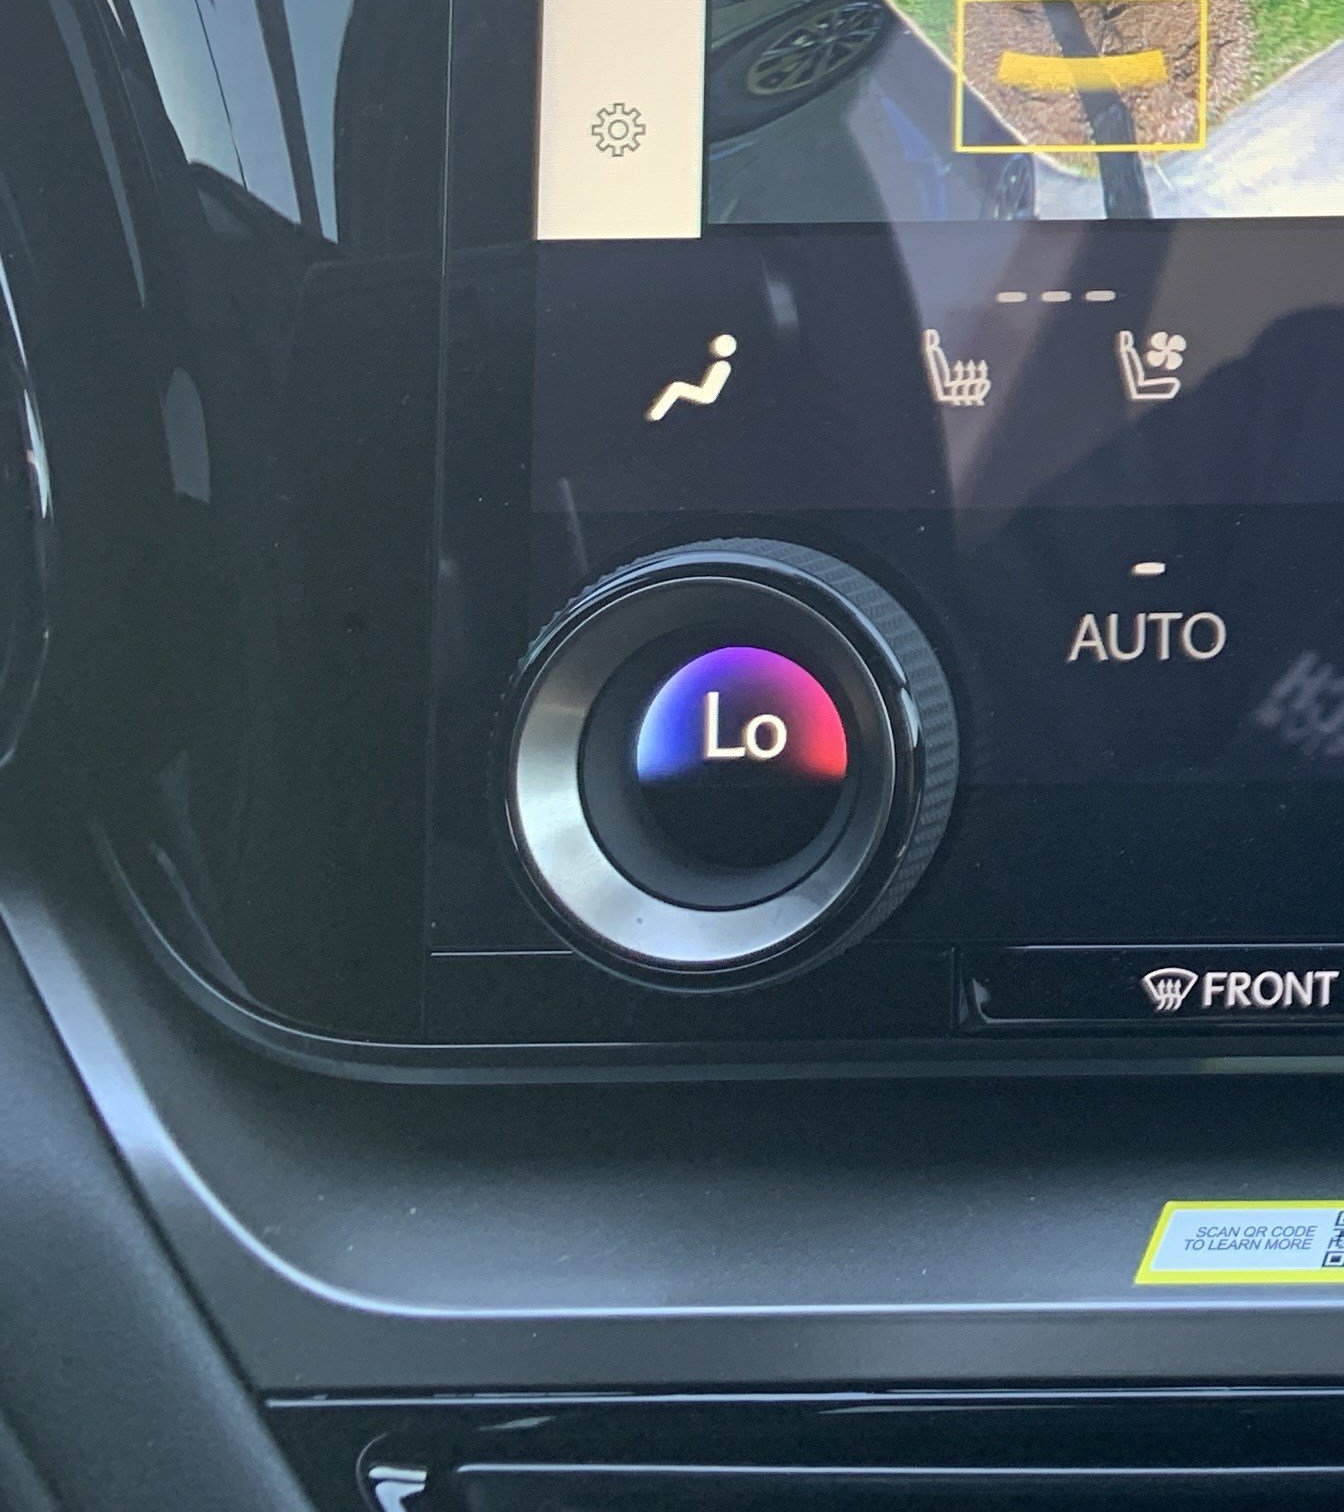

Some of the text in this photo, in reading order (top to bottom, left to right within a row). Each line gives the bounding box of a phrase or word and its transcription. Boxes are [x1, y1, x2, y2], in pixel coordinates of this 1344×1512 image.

[1067, 610, 1227, 663] AUTO
[704, 690, 790, 761] Lo
[1202, 969, 1340, 1008] FRONT
[1184, 1238, 1313, 1250] TO LEARN MORE
[1195, 1225, 1318, 1238] SCAN QR CODE
